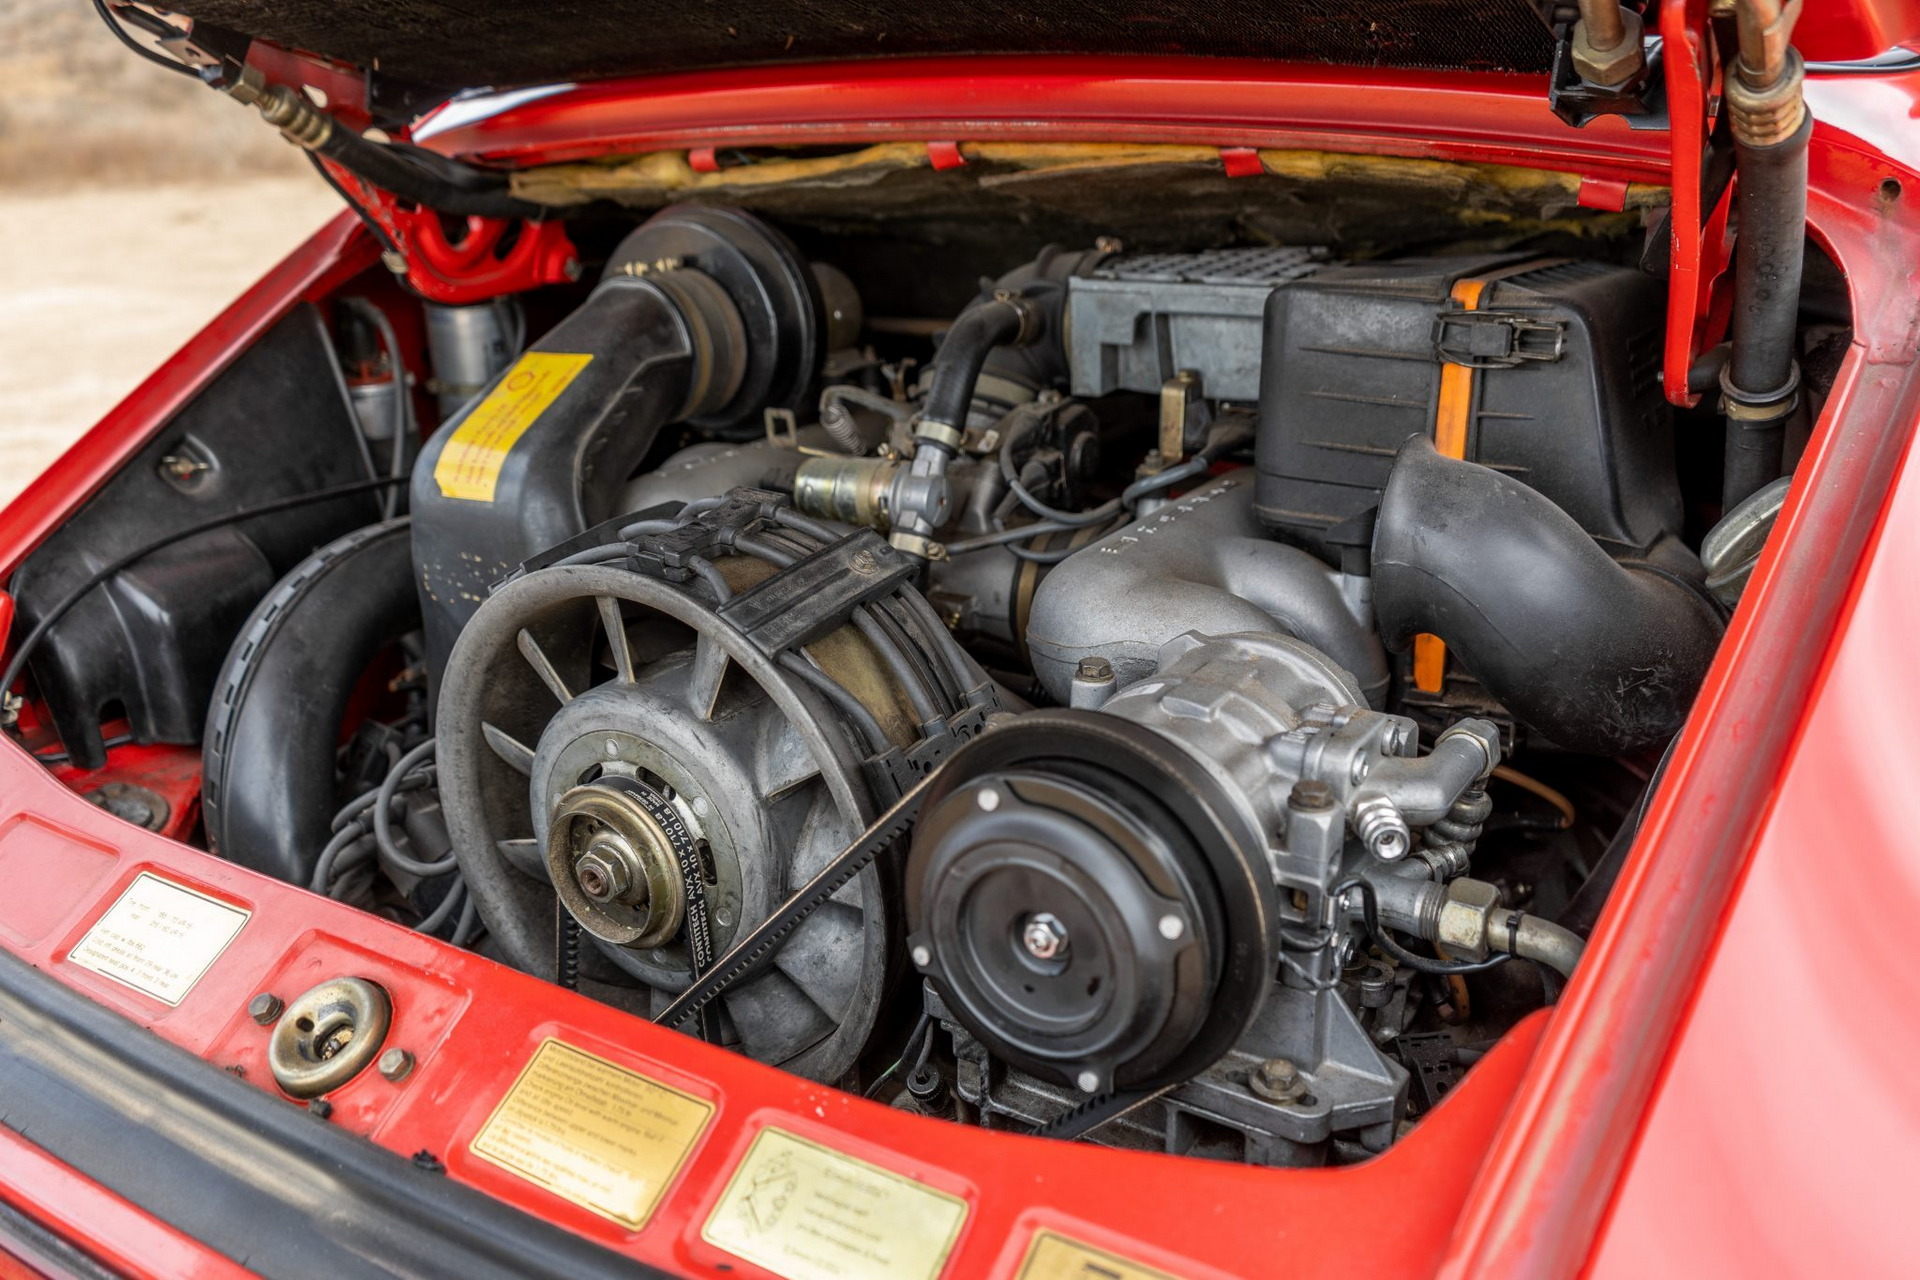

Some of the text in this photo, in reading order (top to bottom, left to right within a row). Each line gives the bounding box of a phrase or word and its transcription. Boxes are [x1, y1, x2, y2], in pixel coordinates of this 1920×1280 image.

[665, 827, 680, 849] 710
[673, 822, 689, 844] 710
[681, 859, 690, 874] 10
[689, 854, 698, 869] 10
[685, 875, 696, 899] AVX
[693, 871, 703, 894] AVX
[690, 904, 705, 967] CONTITECH
